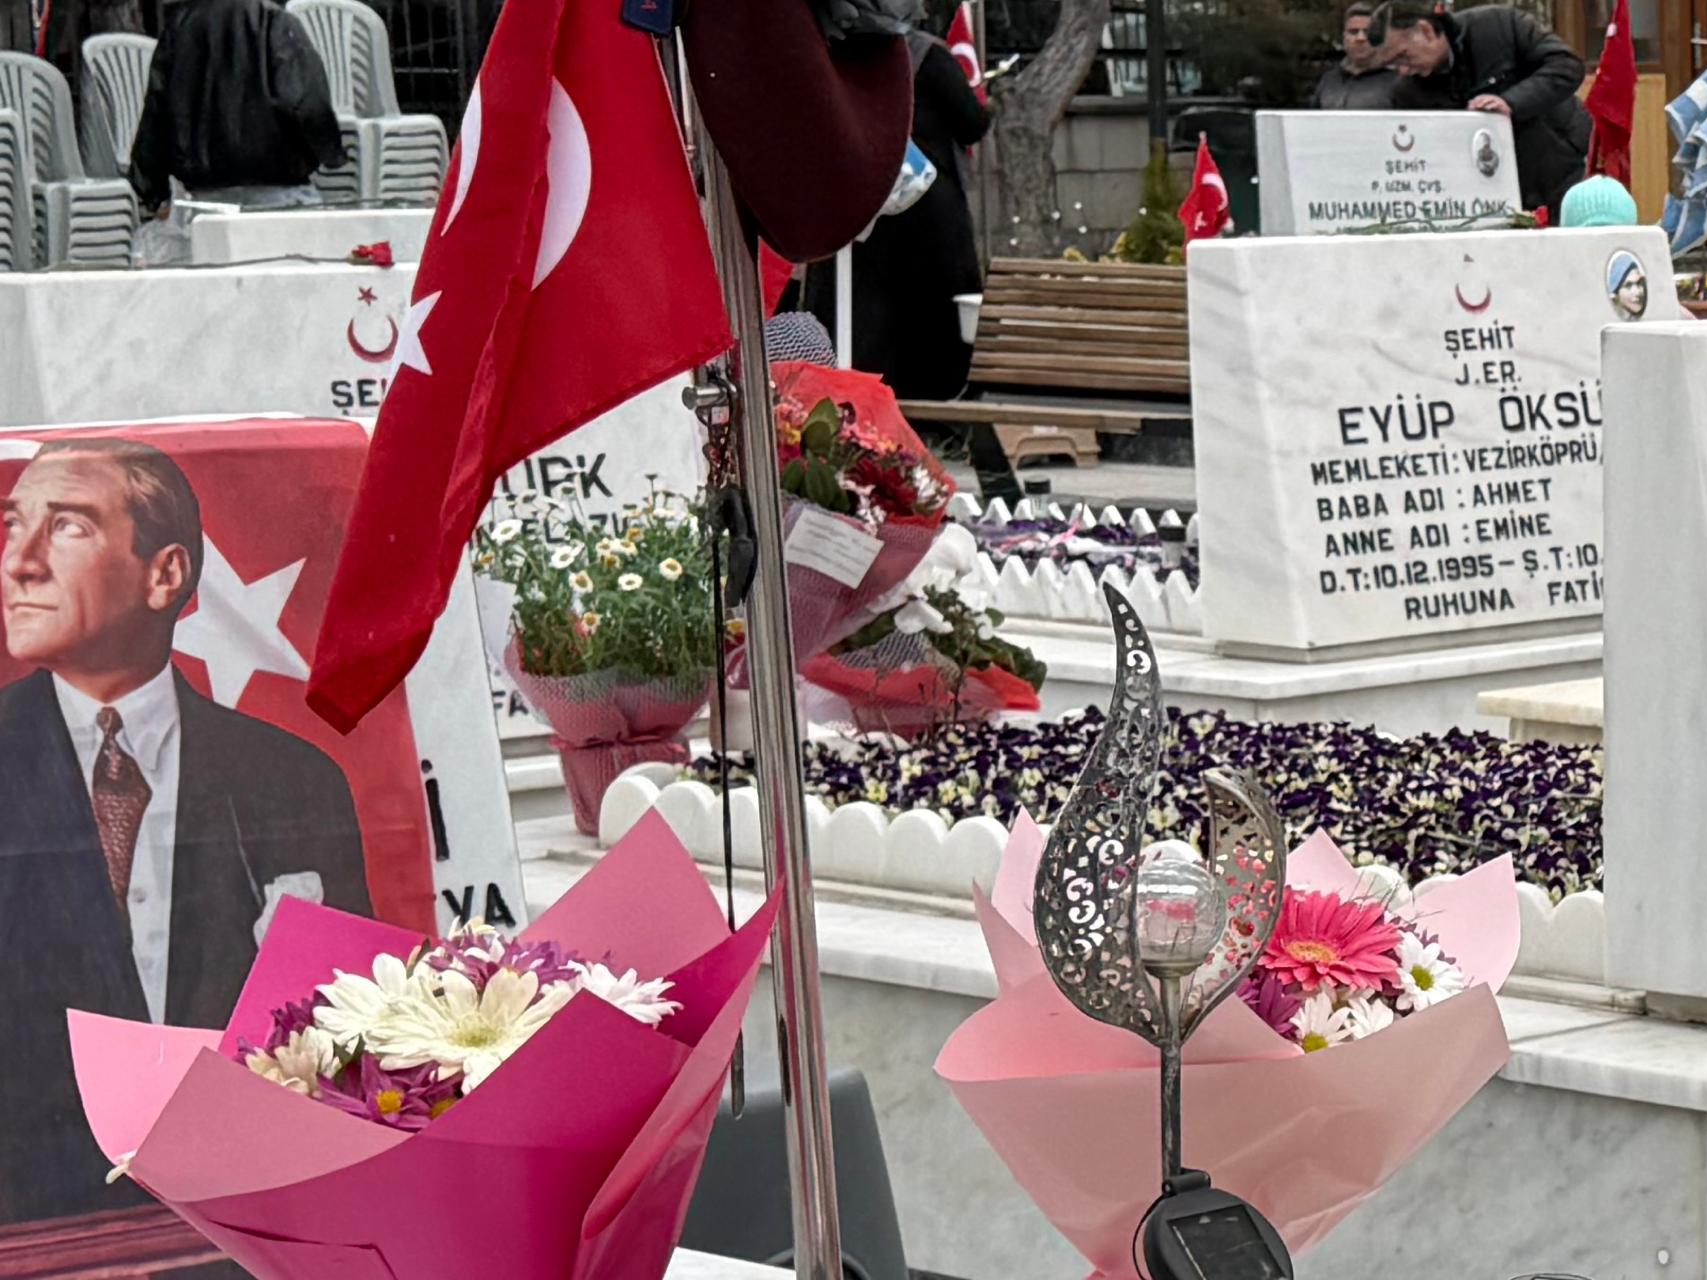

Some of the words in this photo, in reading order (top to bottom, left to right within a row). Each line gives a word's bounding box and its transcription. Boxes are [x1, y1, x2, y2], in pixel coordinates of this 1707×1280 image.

[1385, 159, 1426, 175] ŞEHİT
[1308, 200, 1417, 221] MUHAMMED
[1444, 320, 1516, 360] ŞEHİT
[1455, 360, 1522, 386] J.ER.
[1337, 393, 1455, 446] EYÜP
[1498, 379, 1603, 432] ÖKSÜ
[1316, 493, 1389, 522] BABA
[1403, 487, 1445, 513] ADI
[1325, 528, 1394, 558] ANNE
[1409, 523, 1450, 549] ADI
[1404, 588, 1515, 620] RUHUNA
[1547, 571, 1603, 606] FATİ
